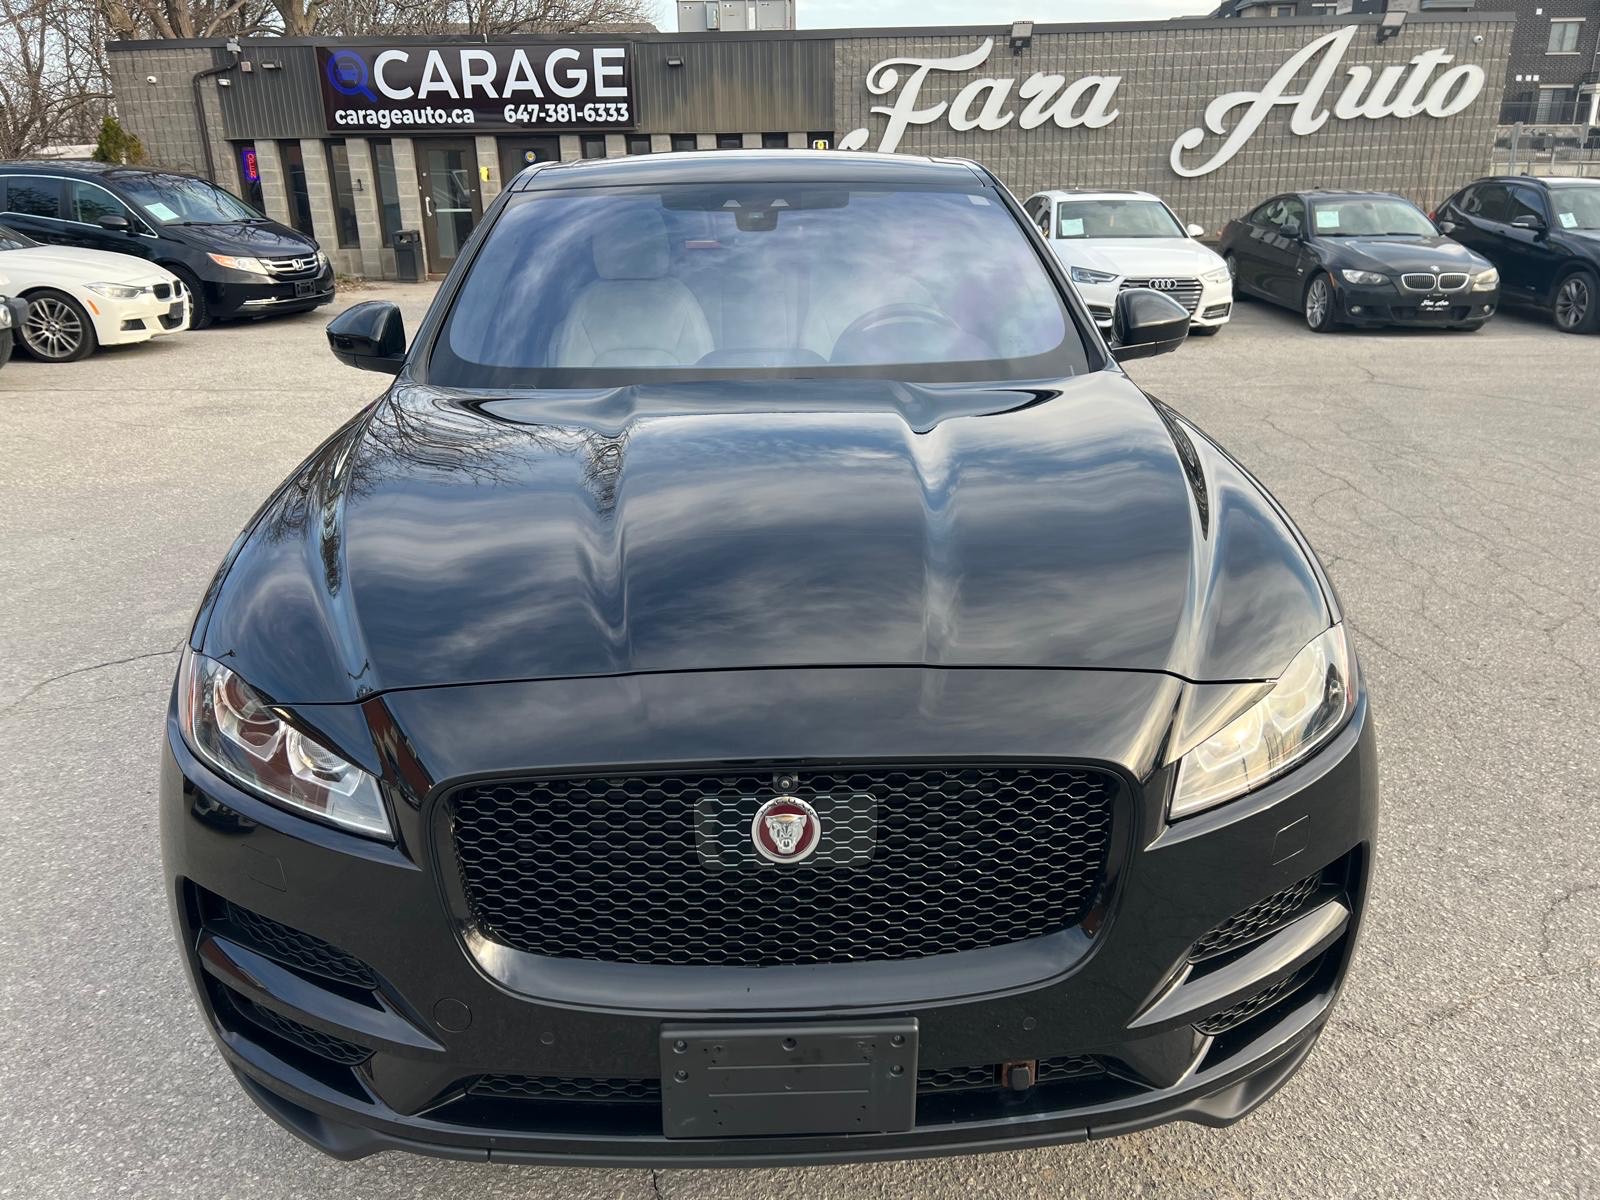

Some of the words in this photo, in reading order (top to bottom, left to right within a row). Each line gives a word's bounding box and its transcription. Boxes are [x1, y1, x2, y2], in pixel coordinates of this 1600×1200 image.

[373, 47, 628, 100] CARAGE
[334, 106, 475, 129] carageauto.ca
[503, 103, 629, 124] 647-381-6333
[838, 37, 1122, 153] Fara
[1169, 24, 1486, 178] Auto
